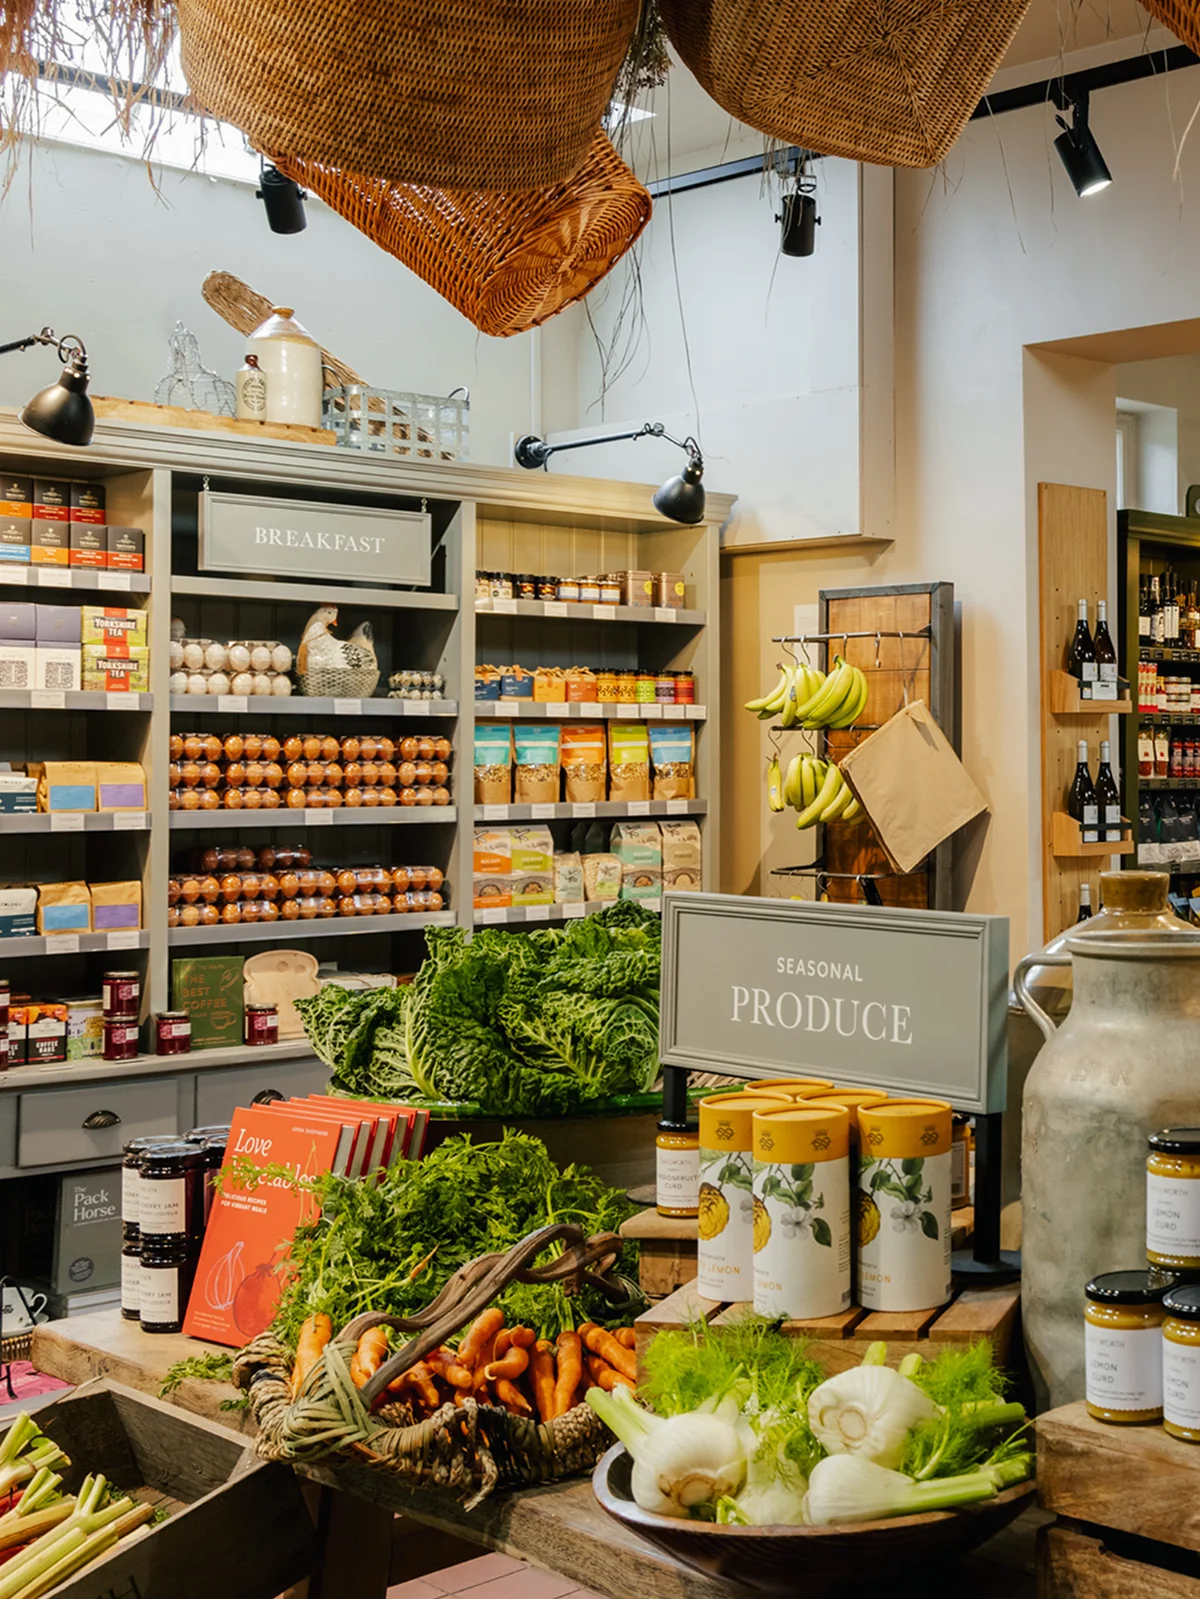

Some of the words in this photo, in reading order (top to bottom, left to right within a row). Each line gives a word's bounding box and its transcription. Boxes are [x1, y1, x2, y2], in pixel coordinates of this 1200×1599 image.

[254, 526, 385, 554] BREAKFAST
[94, 617, 136, 629] YORKSHIRE
[108, 628, 123, 637] TEA
[97, 660, 139, 671] YORKSHIRE
[110, 669, 125, 678] TEA
[776, 957, 863, 982] SEASONAL
[184, 974, 205, 984] THE
[183, 987, 210, 997] BEST
[182, 998, 228, 1011] COFFEE
[730, 985, 913, 1044] PRODUCE
[36, 1040, 58, 1048] COFFEE
[234, 1128, 272, 1156] Love
[664, 1182, 683, 1190] CURD
[74, 1190, 108, 1207] Pack
[247, 1196, 267, 1206] RECIPES
[74, 1205, 116, 1221] Horse
[231, 1202, 251, 1210] VIBRANT
[251, 1205, 267, 1214] MEALS
[1153, 1208, 1180, 1219] LEMON
[1155, 1220, 1177, 1231] CURD
[708, 1265, 741, 1275] LEMON
[862, 1271, 891, 1283] LEMON
[1090, 1360, 1118, 1372] LEMON
[1092, 1372, 1115, 1384] CURD
